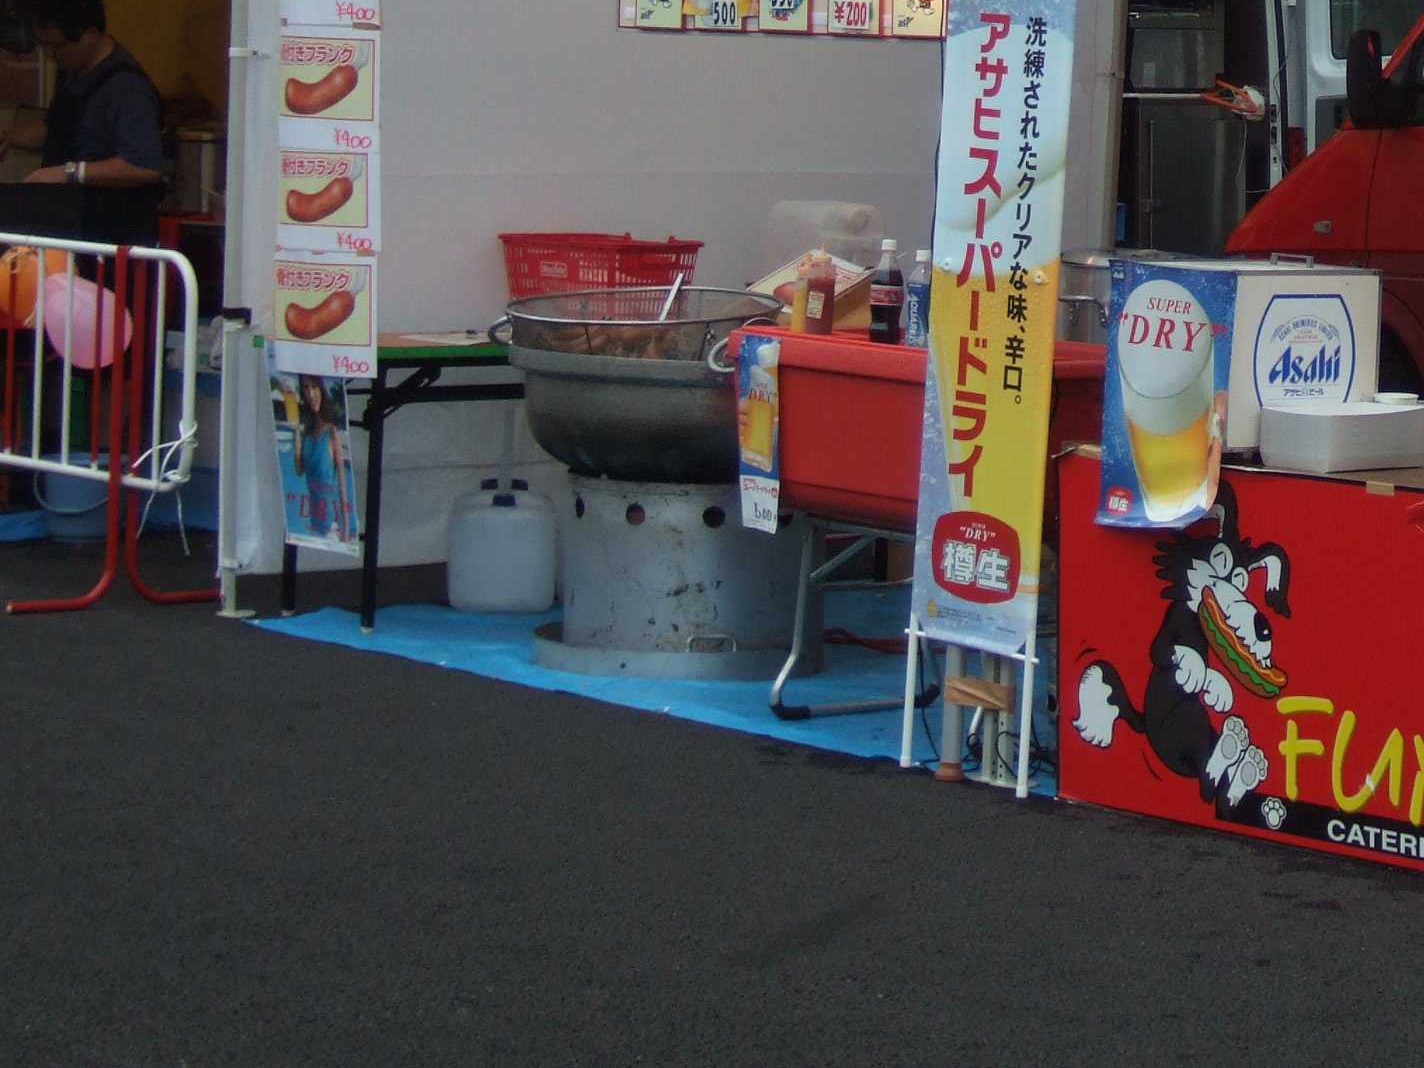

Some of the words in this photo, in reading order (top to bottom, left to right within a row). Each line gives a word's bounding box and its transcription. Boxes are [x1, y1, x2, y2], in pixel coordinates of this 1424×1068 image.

[713, 1, 736, 26] 500
[834, 0, 867, 26] ¥200
[949, 13, 1012, 498] アサヒスーパードライ
[1147, 297, 1192, 315] SUPER
[1268, 343, 1341, 385] Asahi
[942, 540, 1009, 593] 樽生
